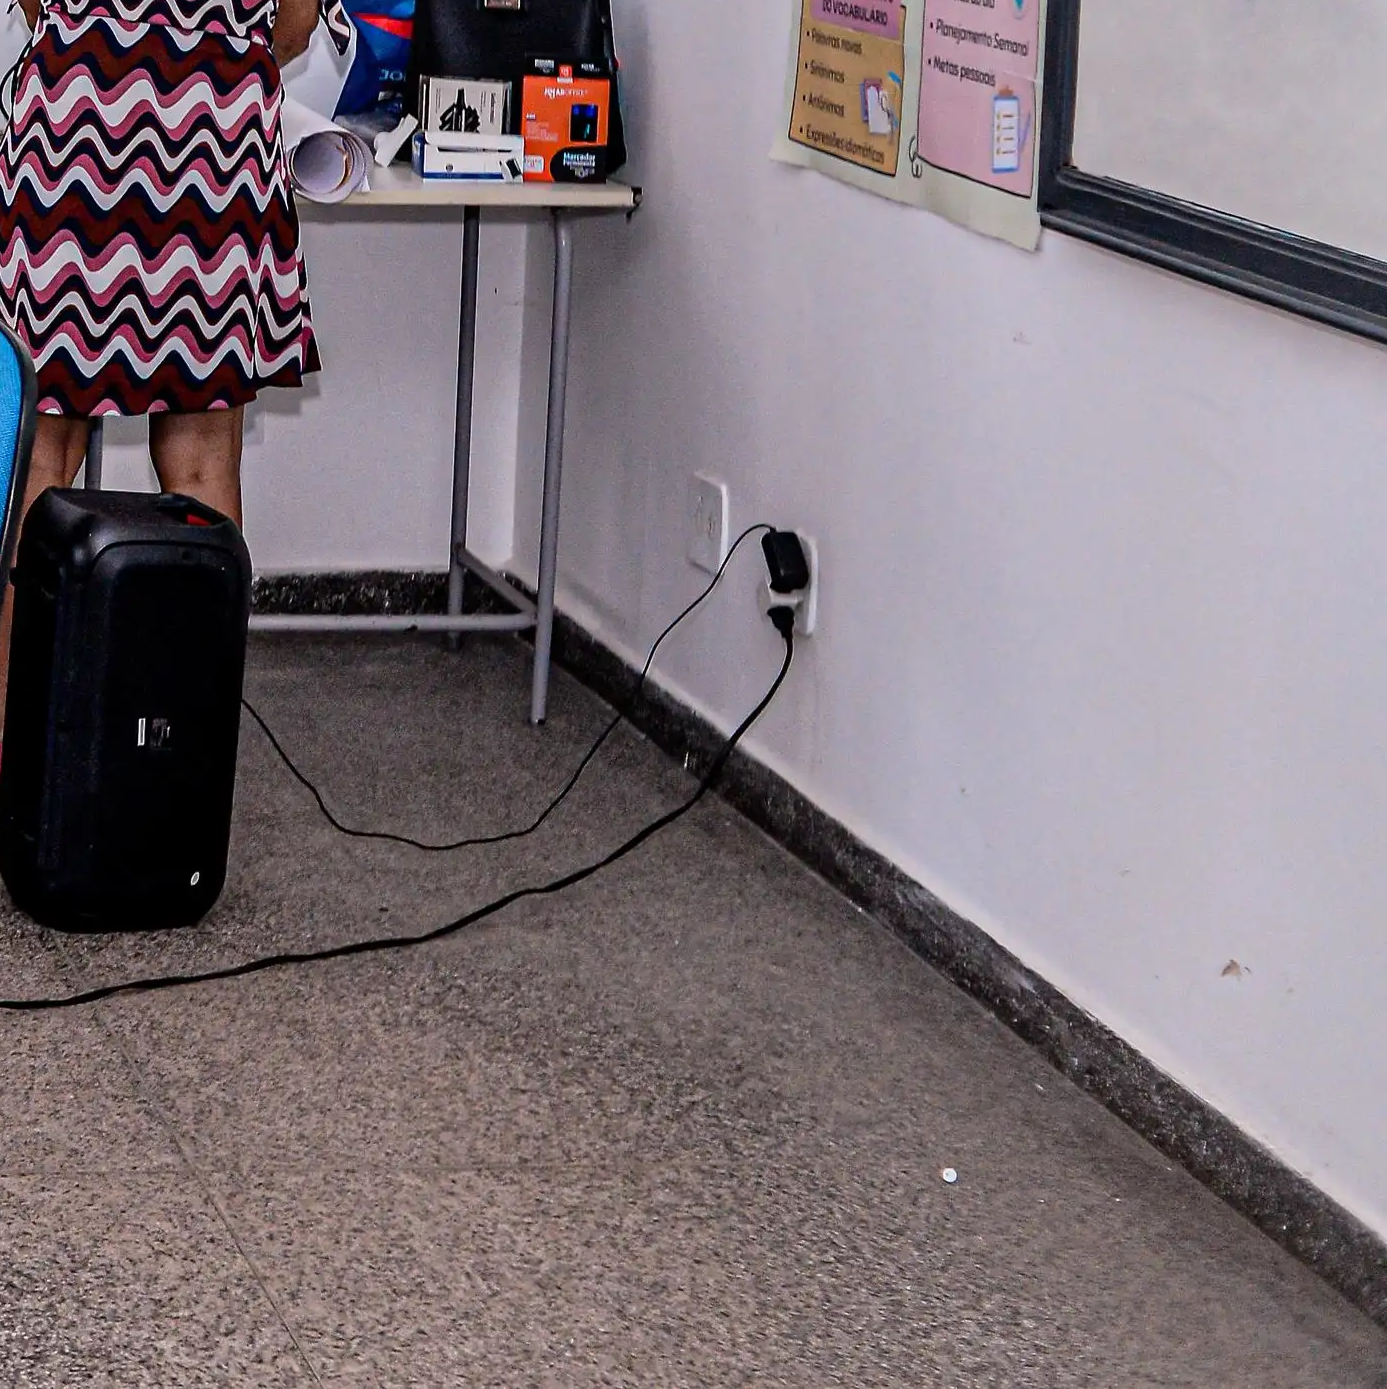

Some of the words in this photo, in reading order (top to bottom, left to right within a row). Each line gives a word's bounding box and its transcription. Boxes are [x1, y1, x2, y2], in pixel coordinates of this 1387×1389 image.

[936, 18, 993, 48] Planejamento
[994, 32, 1030, 57] Semanal
[379, 68, 406, 82] JO
[933, 55, 959, 78] Metas
[960, 65, 996, 88] pessoais
